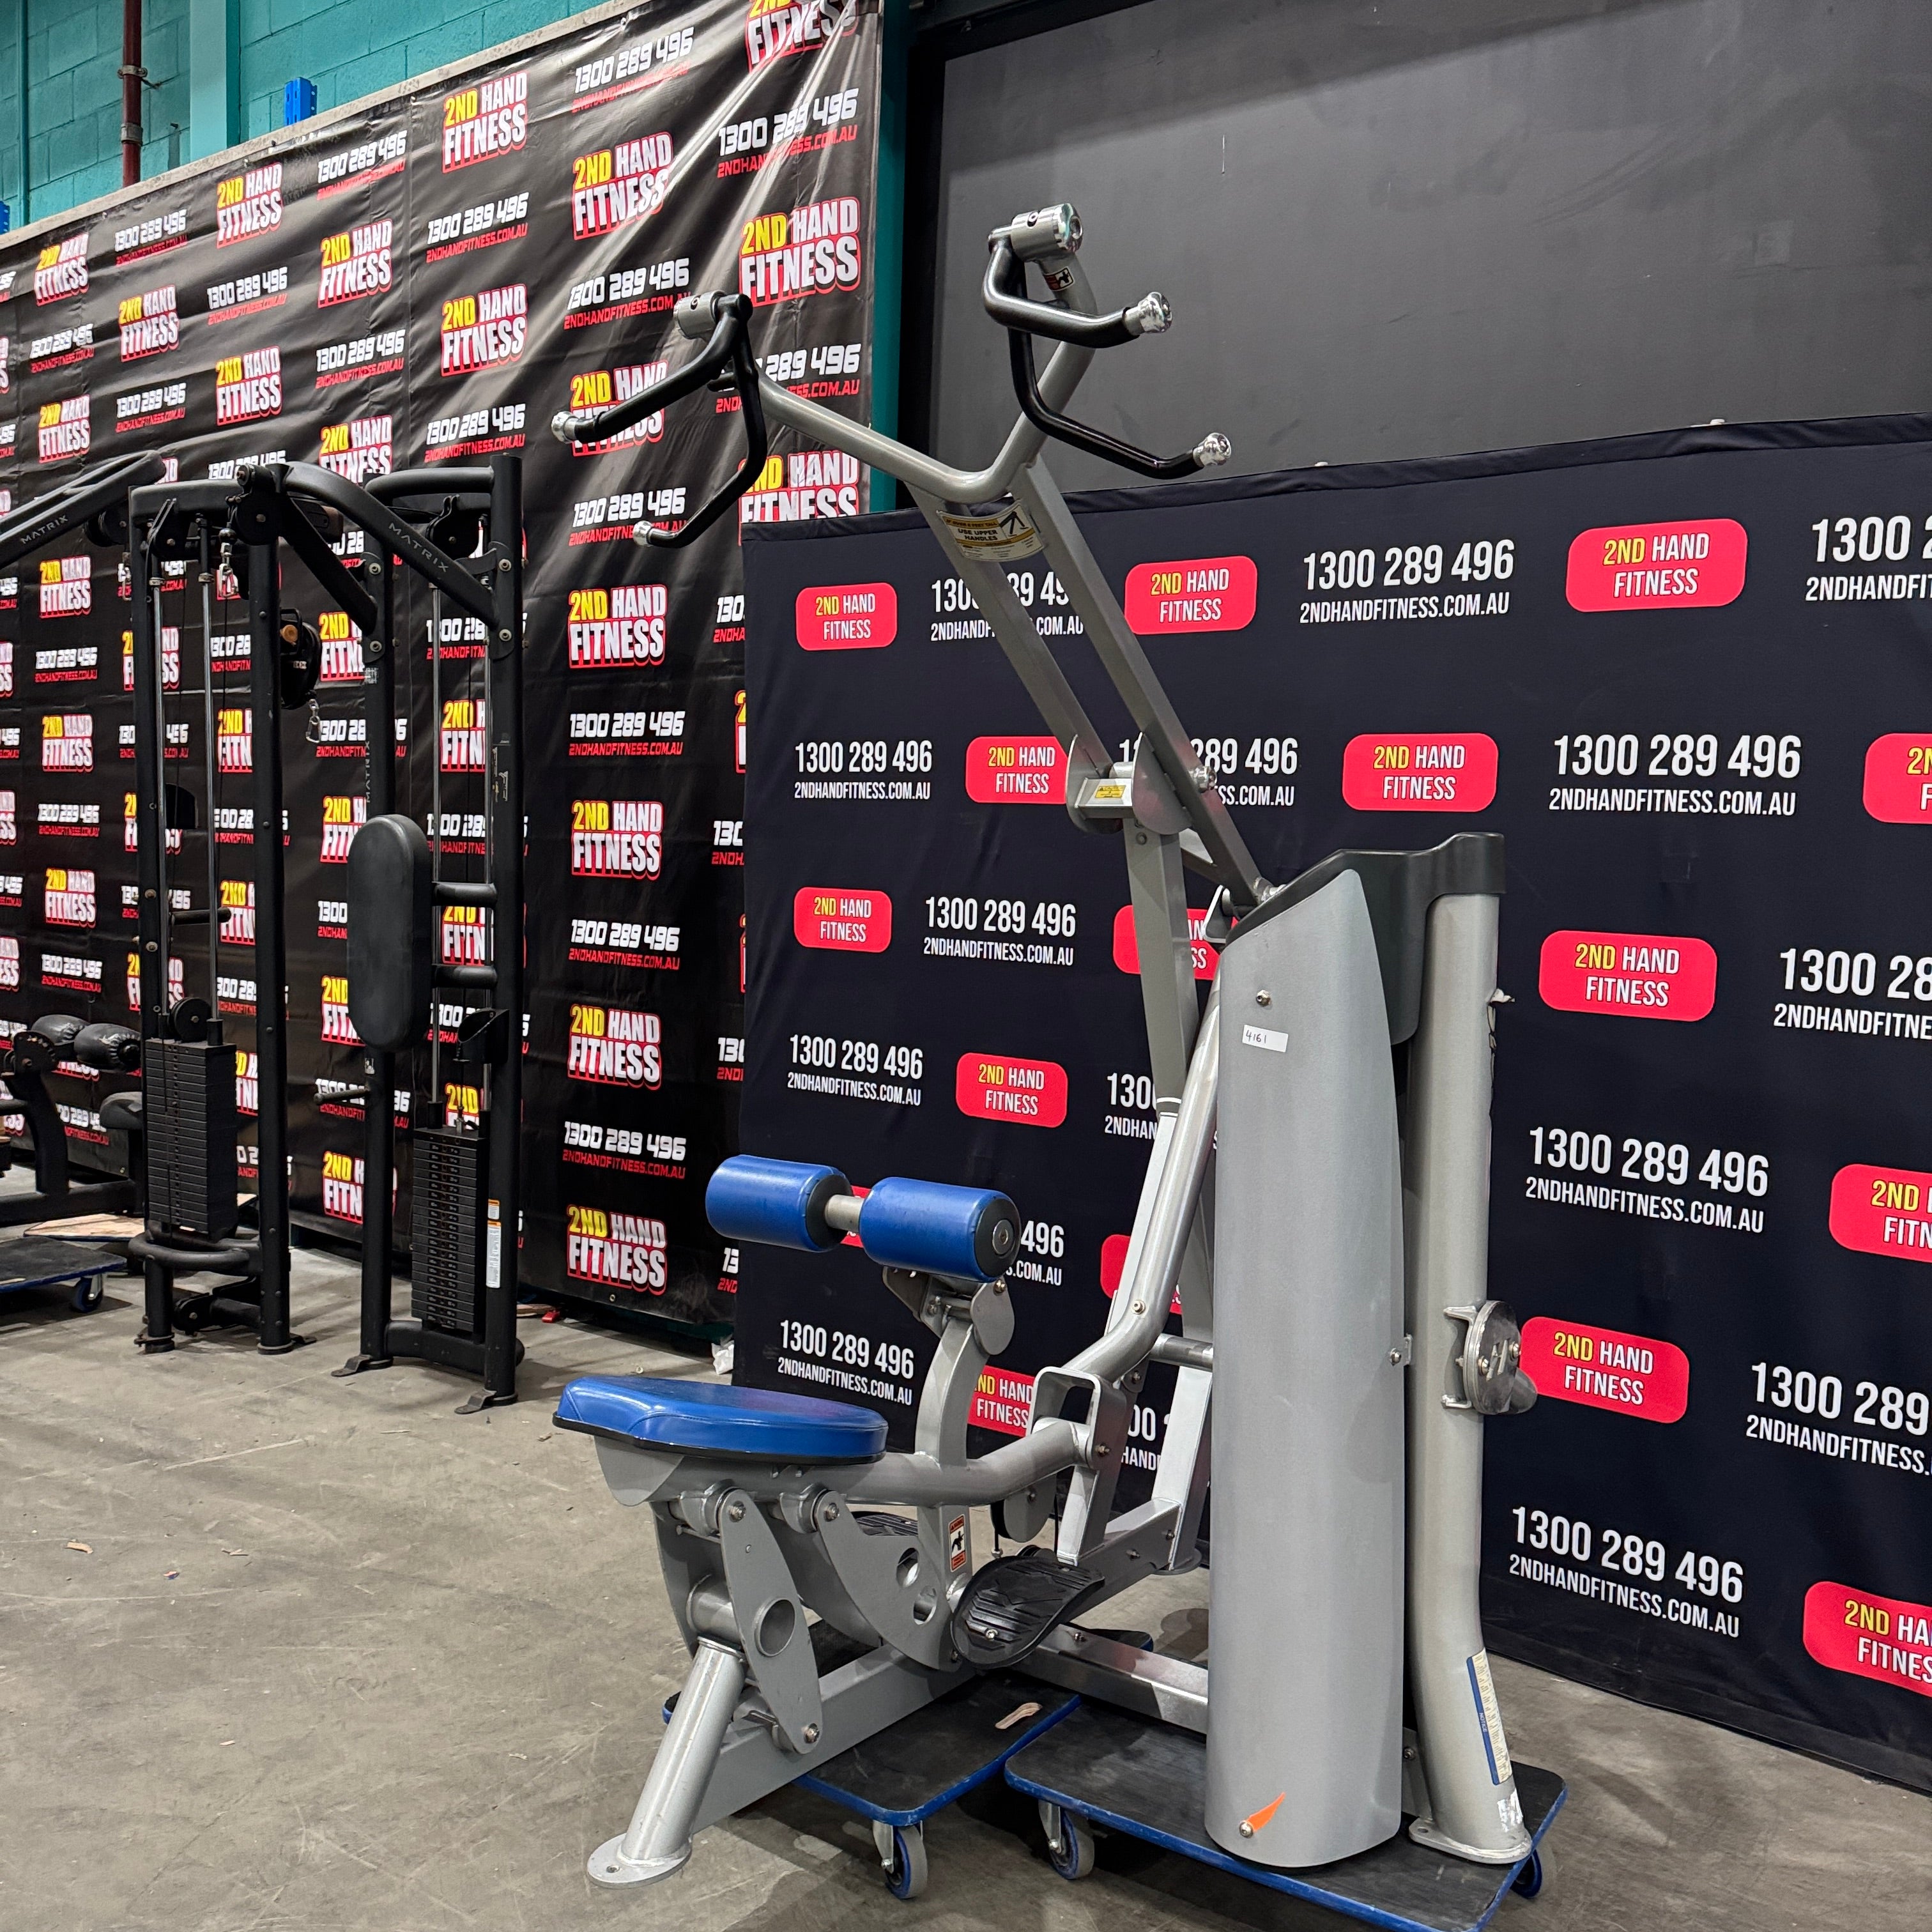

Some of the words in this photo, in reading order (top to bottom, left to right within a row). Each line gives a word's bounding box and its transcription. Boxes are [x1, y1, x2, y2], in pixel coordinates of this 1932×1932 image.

[445, 89, 478, 126] 2ND
[481, 72, 527, 115] HAND
[445, 103, 526, 165] FITNESS
[719, 118, 767, 155] 1300
[772, 103, 809, 144] 289
[815, 89, 859, 126] 496
[574, 151, 611, 189] 2ND
[617, 135, 671, 179] HAND
[218, 178, 243, 208] 2ND
[247, 165, 282, 198] HAND
[574, 169, 671, 231] FITNESS
[218, 192, 282, 241] FITNESS
[427, 212, 461, 244] 1300
[464, 204, 494, 233] 289
[496, 193, 529, 223] 496
[743, 215, 786, 254] 2ND
[792, 200, 857, 243] HAND
[322, 234, 350, 266] 2ND
[354, 220, 392, 256] HAND
[320, 250, 391, 300] FITNESS
[742, 236, 857, 298] FITNESS
[207, 282, 234, 309] 1300
[236, 275, 260, 302] 289
[263, 267, 287, 293] 496
[443, 296, 475, 330] 2ND
[479, 286, 526, 322] HAND
[121, 313, 178, 355] FITNESS
[316, 344, 346, 372] 1300
[348, 337, 376, 364] 289
[378, 330, 406, 356] 496
[443, 318, 525, 368] FITNESS
[216, 358, 241, 385] 2ND
[244, 347, 280, 378] HAND
[217, 375, 280, 418] FITNESS
[790, 452, 857, 488] HAND
[572, 498, 607, 527] 1300
[608, 493, 643, 521] 289
[648, 487, 686, 516] 496
[741, 486, 857, 523] FITNESS
[20, 515, 68, 544] MATRIX
[388, 523, 448, 572] MATRIX
[1813, 516, 1910, 562] 1300
[1304, 549, 1375, 590] 1300
[1384, 545, 1443, 586] 289
[1452, 539, 1514, 581] 496
[1604, 539, 1644, 565] 2ND
[1652, 533, 1709, 561] HAND
[40, 580, 90, 612] FITNESS
[1151, 573, 1181, 595] 2ND
[1187, 569, 1229, 592] HAND
[1614, 569, 1698, 597] FITNESS
[570, 591, 607, 621] 2ND
[612, 586, 666, 618] HAND
[816, 596, 839, 615] 2ND
[843, 594, 875, 614] HAND
[1160, 598, 1221, 622] FITNESS
[1300, 592, 1509, 623] 2NDHANDFITNESS.COM.AU
[570, 618, 664, 660] FITNESS
[824, 619, 871, 640] FITNESS
[571, 714, 610, 737] 1300
[611, 712, 646, 737] 289
[650, 711, 685, 736] 496
[569, 742, 683, 756] 2NDHANDFITNESS.COM.AU
[795, 742, 843, 772] 1300
[849, 741, 886, 772] 289
[893, 740, 931, 772] 496
[989, 747, 1014, 766] 2ND
[1019, 747, 1055, 766] HAND
[1245, 738, 1298, 774] 496
[1374, 746, 1409, 768] 2ND
[1416, 746, 1464, 768] HAND
[1554, 735, 1638, 775] 1300
[1649, 735, 1717, 776] 289
[1728, 735, 1800, 778] 496
[795, 782, 930, 799] 2NDHANDFITNESS.COM.AU
[996, 773, 1048, 793] FITNESS
[1384, 776, 1455, 799] FITNESS
[1549, 788, 1795, 815] 2NDHANDFITNESS.COM.AU
[574, 802, 608, 830] 2ND
[613, 803, 662, 832] HAND
[573, 832, 660, 872] FITNESS
[45, 891, 95, 922] FITNESS
[815, 897, 836, 916] 2ND
[840, 898, 871, 917] HAND
[926, 897, 977, 930] 1300
[984, 900, 1025, 933] 289
[1032, 903, 1076, 937] 496
[821, 921, 866, 942] FITNESS
[924, 937, 1073, 965] 2NDHANDFITNESS.COM.AU
[1575, 944, 1615, 969] 2ND
[1623, 947, 1679, 974] HAND
[1781, 949, 1876, 995] 1300
[1586, 977, 1668, 1006] FITNESS
[572, 1006, 604, 1036] 2ND
[608, 1011, 659, 1043] HAND
[1245, 1029, 1267, 1044] 4161
[569, 1037, 659, 1082] FITNESS
[790, 1034, 836, 1068] 1300
[841, 1040, 878, 1073] 289
[884, 1046, 923, 1079] 496
[788, 1072, 921, 1105] 2NDHANDFITNESS.COM.AU
[979, 1064, 1004, 1084] 2ND
[1009, 1068, 1044, 1089] HAND
[986, 1090, 1038, 1115] FITNESS
[565, 1121, 602, 1149] 1300
[605, 1128, 643, 1154] 289
[647, 1134, 686, 1160] 496
[323, 1152, 351, 1181] 2ND
[563, 1149, 685, 1179] 2NDHANDFITNESS.COM.AU
[1530, 1127, 1611, 1174] 1300
[1622, 1138, 1689, 1184] 289
[1699, 1149, 1768, 1196] 496
[1526, 1177, 1763, 1232] 2NDHANDFITNESS.COM.AU
[1872, 1181, 1919, 1210] 2ND
[569, 1207, 607, 1238] 2ND
[611, 1215, 666, 1248] HAND
[1021, 1221, 1064, 1257] 496
[569, 1235, 664, 1287] FITNESS
[781, 1320, 826, 1356] 1300
[832, 1331, 869, 1367] 289
[875, 1343, 914, 1379] 496
[1554, 1333, 1593, 1361] 2ND
[1600, 1341, 1653, 1374] HAND
[778, 1357, 912, 1405] 2NDHANDFITNESS.COM.AU
[1000, 1379, 1032, 1404] HAND
[1565, 1365, 1643, 1404] FITNESS
[1752, 1363, 1842, 1418] 1300
[1854, 1382, 1929, 1435] 289
[977, 1399, 1028, 1429] FITNESS
[1513, 1506, 1591, 1561] 1300
[1602, 1530, 1665, 1581] 289
[1675, 1551, 1743, 1602] 496
[1510, 1554, 1738, 1637] 2NDHANDFITNESS.COM.AU
[1845, 1600, 1889, 1635] 2ND
[1859, 1637, 1932, 1683] FITNES
[1478, 1712, 1487, 1733] NOTICE
